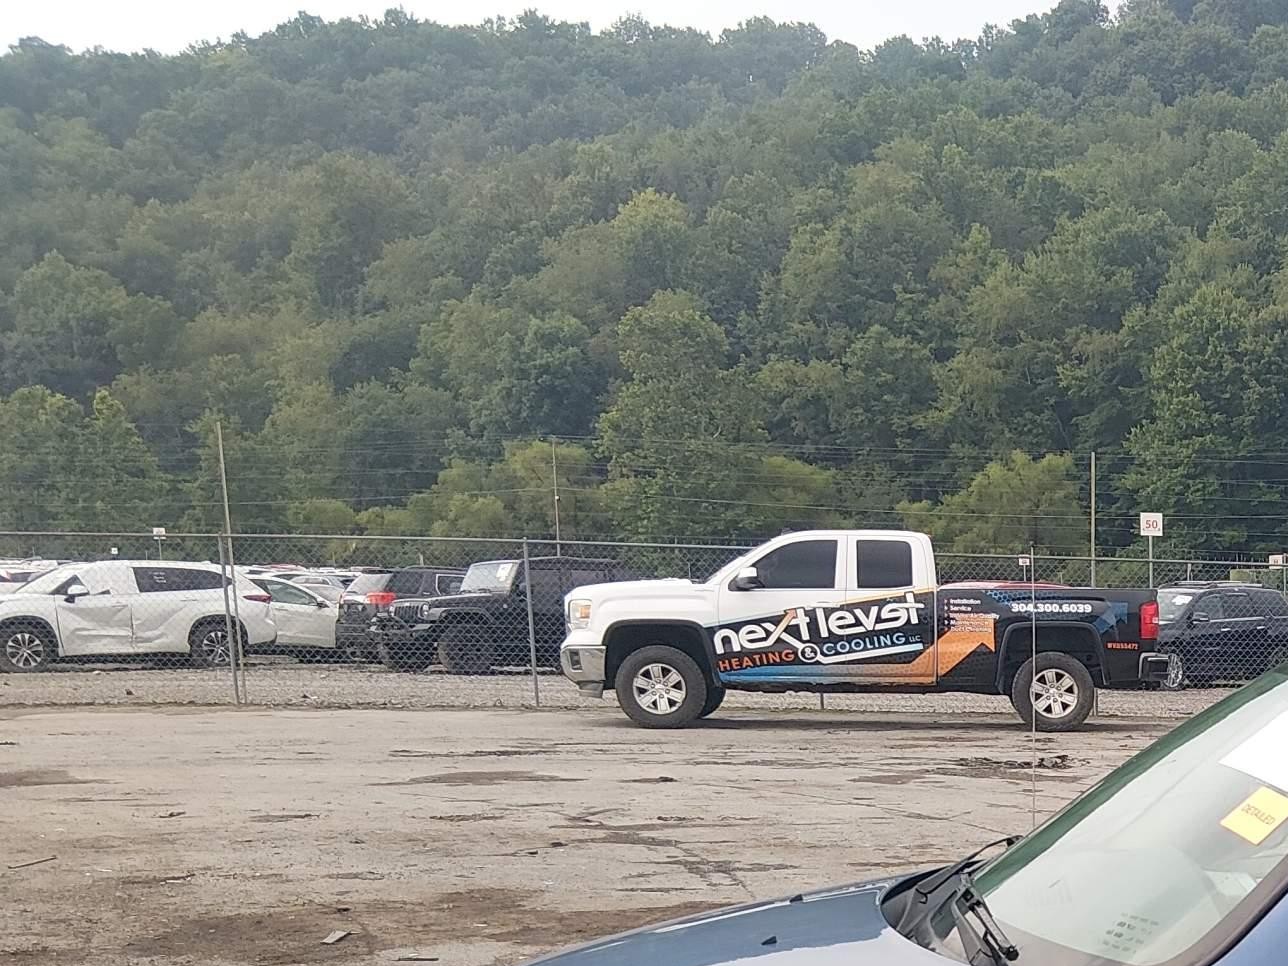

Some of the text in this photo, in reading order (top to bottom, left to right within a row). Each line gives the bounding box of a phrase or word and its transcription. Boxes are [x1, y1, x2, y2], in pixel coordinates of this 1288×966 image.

[1145, 519, 1158, 529] 50
[1011, 603, 1093, 613] 304.300.6039
[718, 649, 796, 672] HEATING
[822, 631, 906, 656] COOLING
[908, 634, 921, 643] LLC
